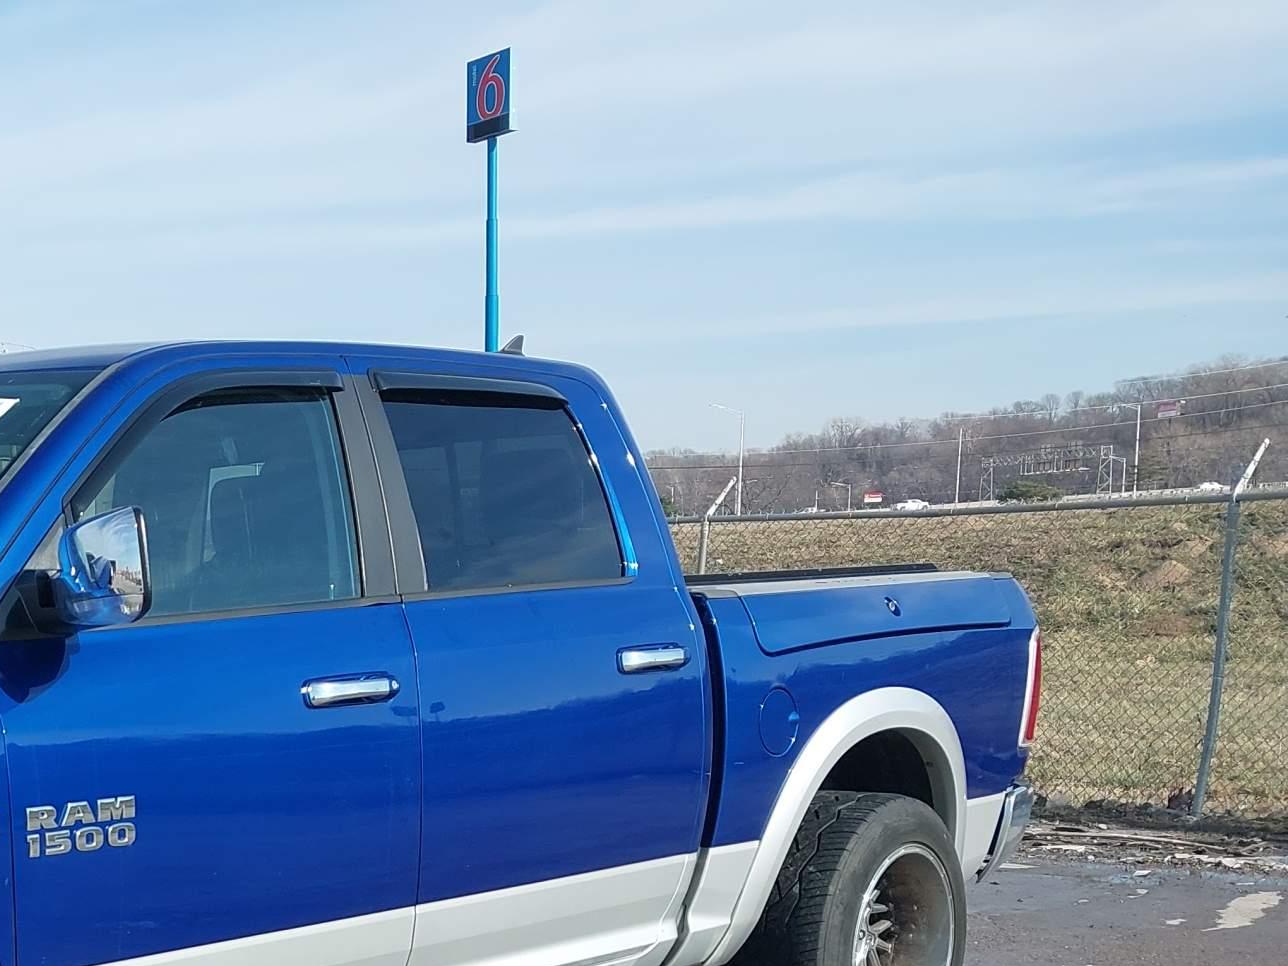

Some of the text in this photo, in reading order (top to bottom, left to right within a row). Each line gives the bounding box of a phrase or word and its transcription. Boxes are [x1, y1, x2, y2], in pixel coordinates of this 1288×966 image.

[476, 54, 505, 120] 6
[25, 795, 136, 832] RAM
[27, 822, 136, 858] 1500
